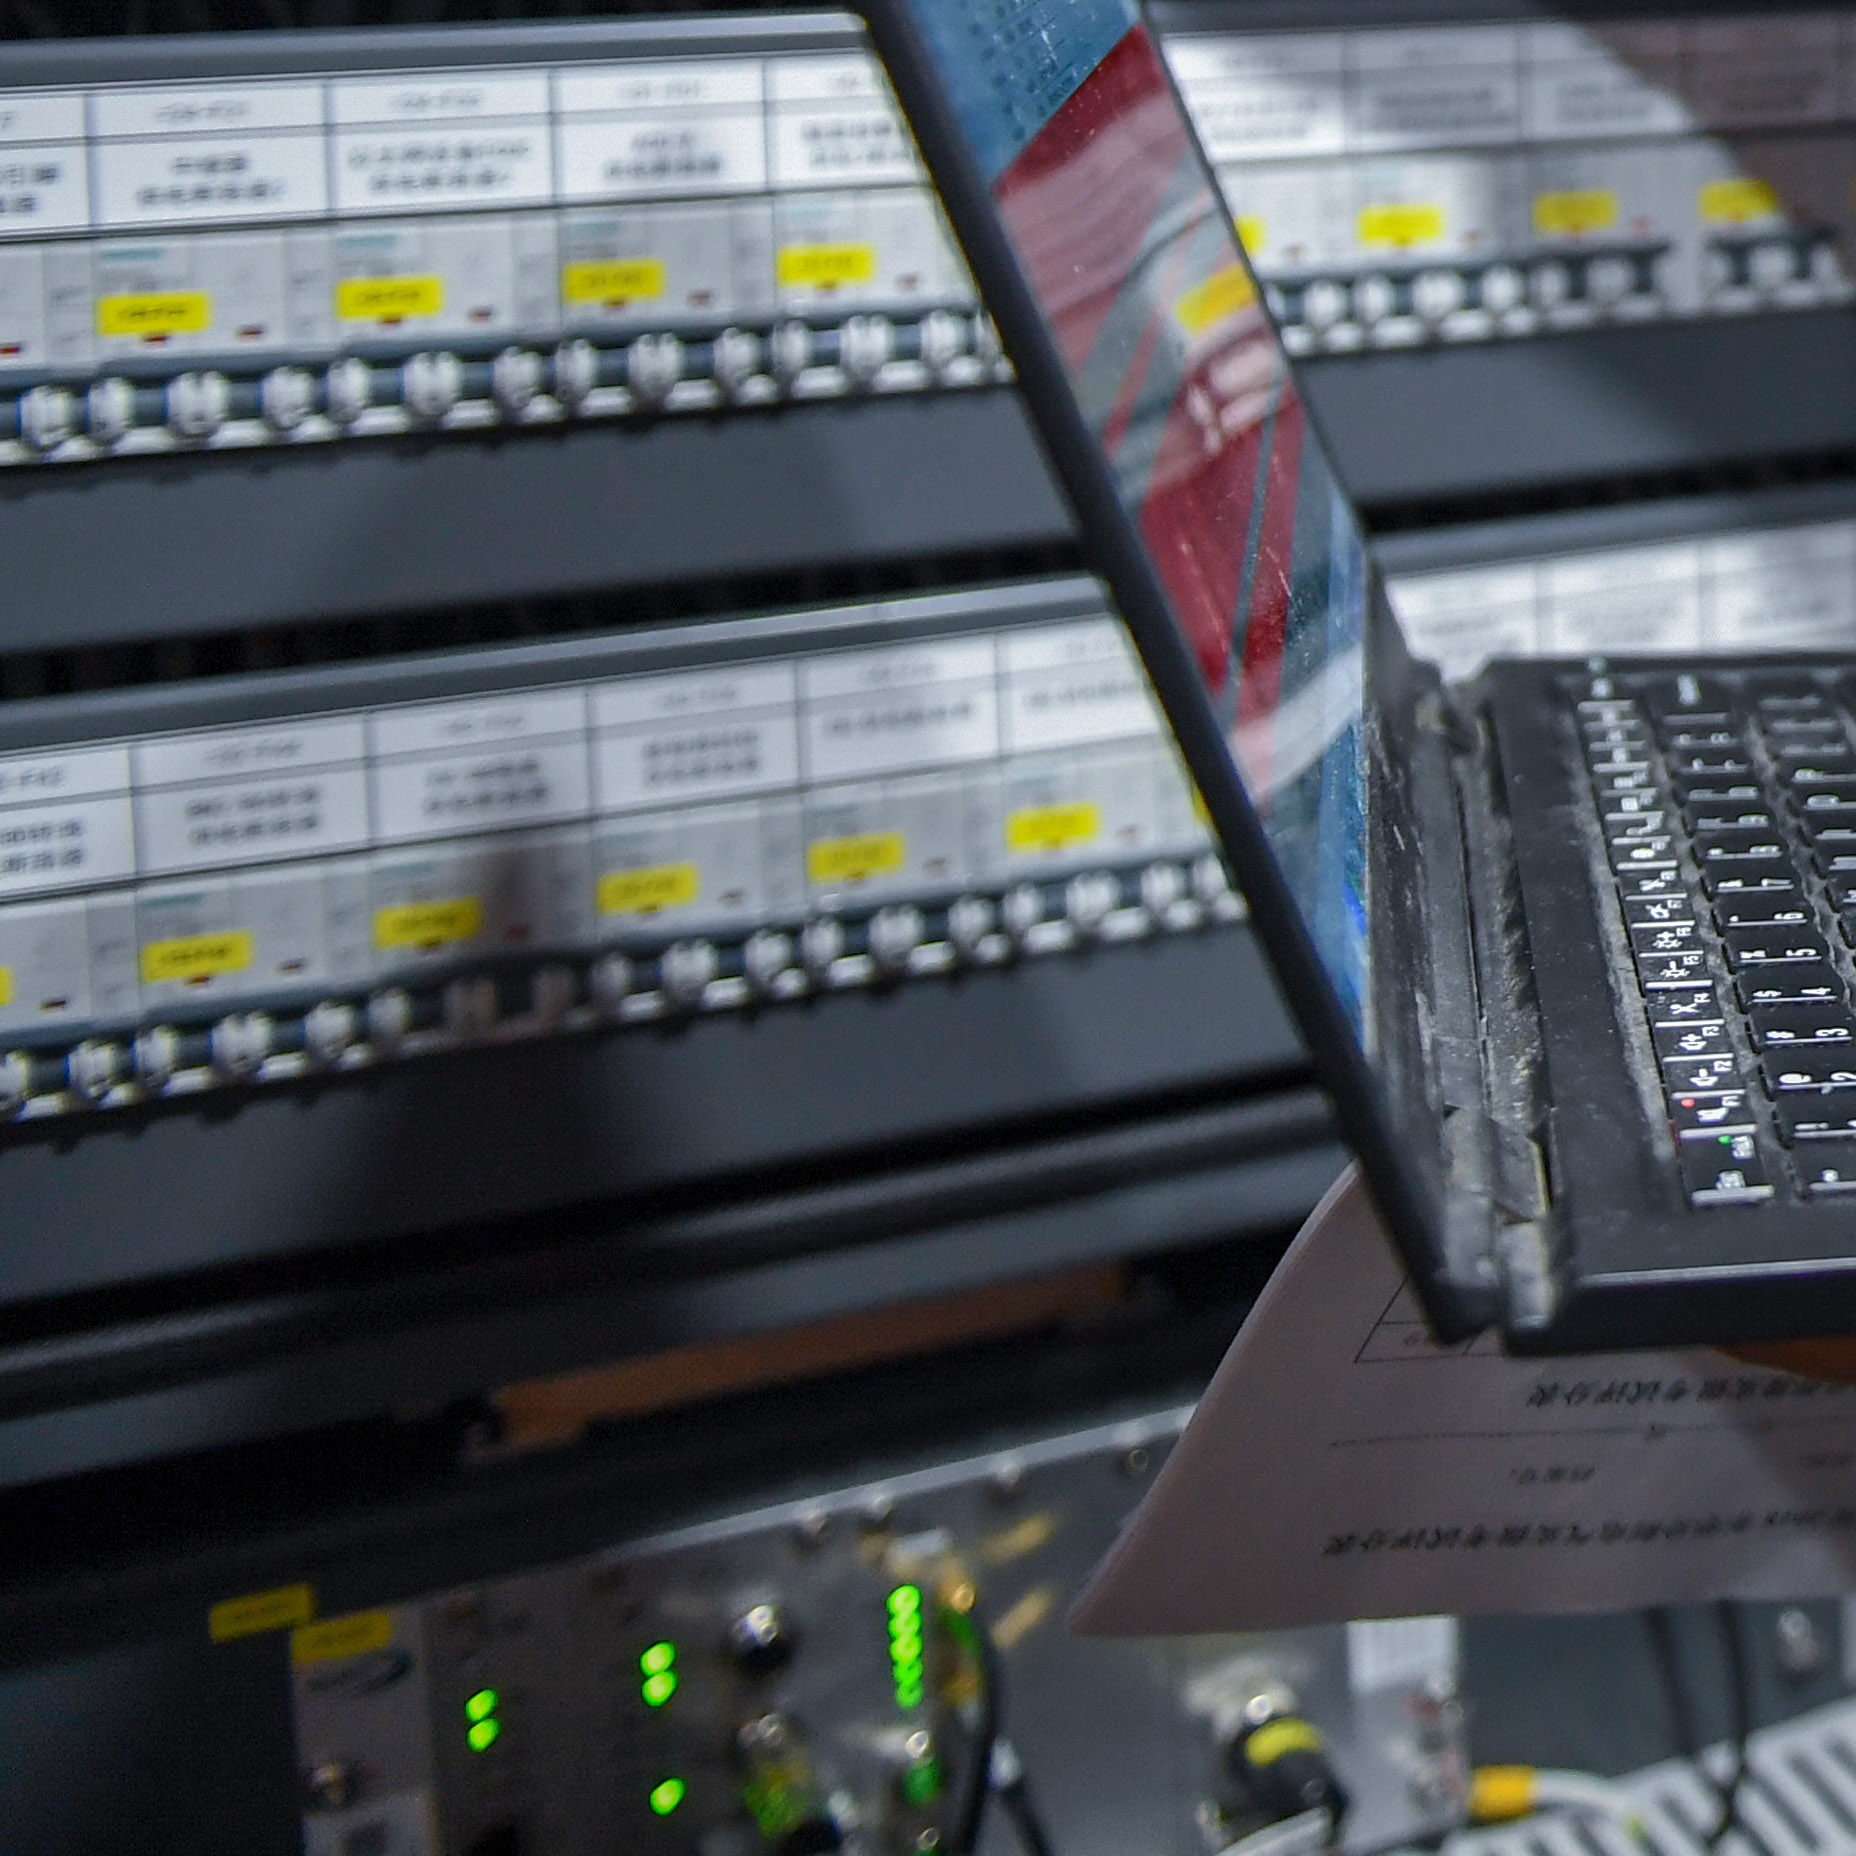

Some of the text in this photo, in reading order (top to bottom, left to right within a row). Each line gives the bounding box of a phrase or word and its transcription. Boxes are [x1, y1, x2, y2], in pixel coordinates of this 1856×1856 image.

[1786, 947, 1817, 957] 5
[1801, 986, 1831, 996] 4
[1815, 1027, 1849, 1037] 3
